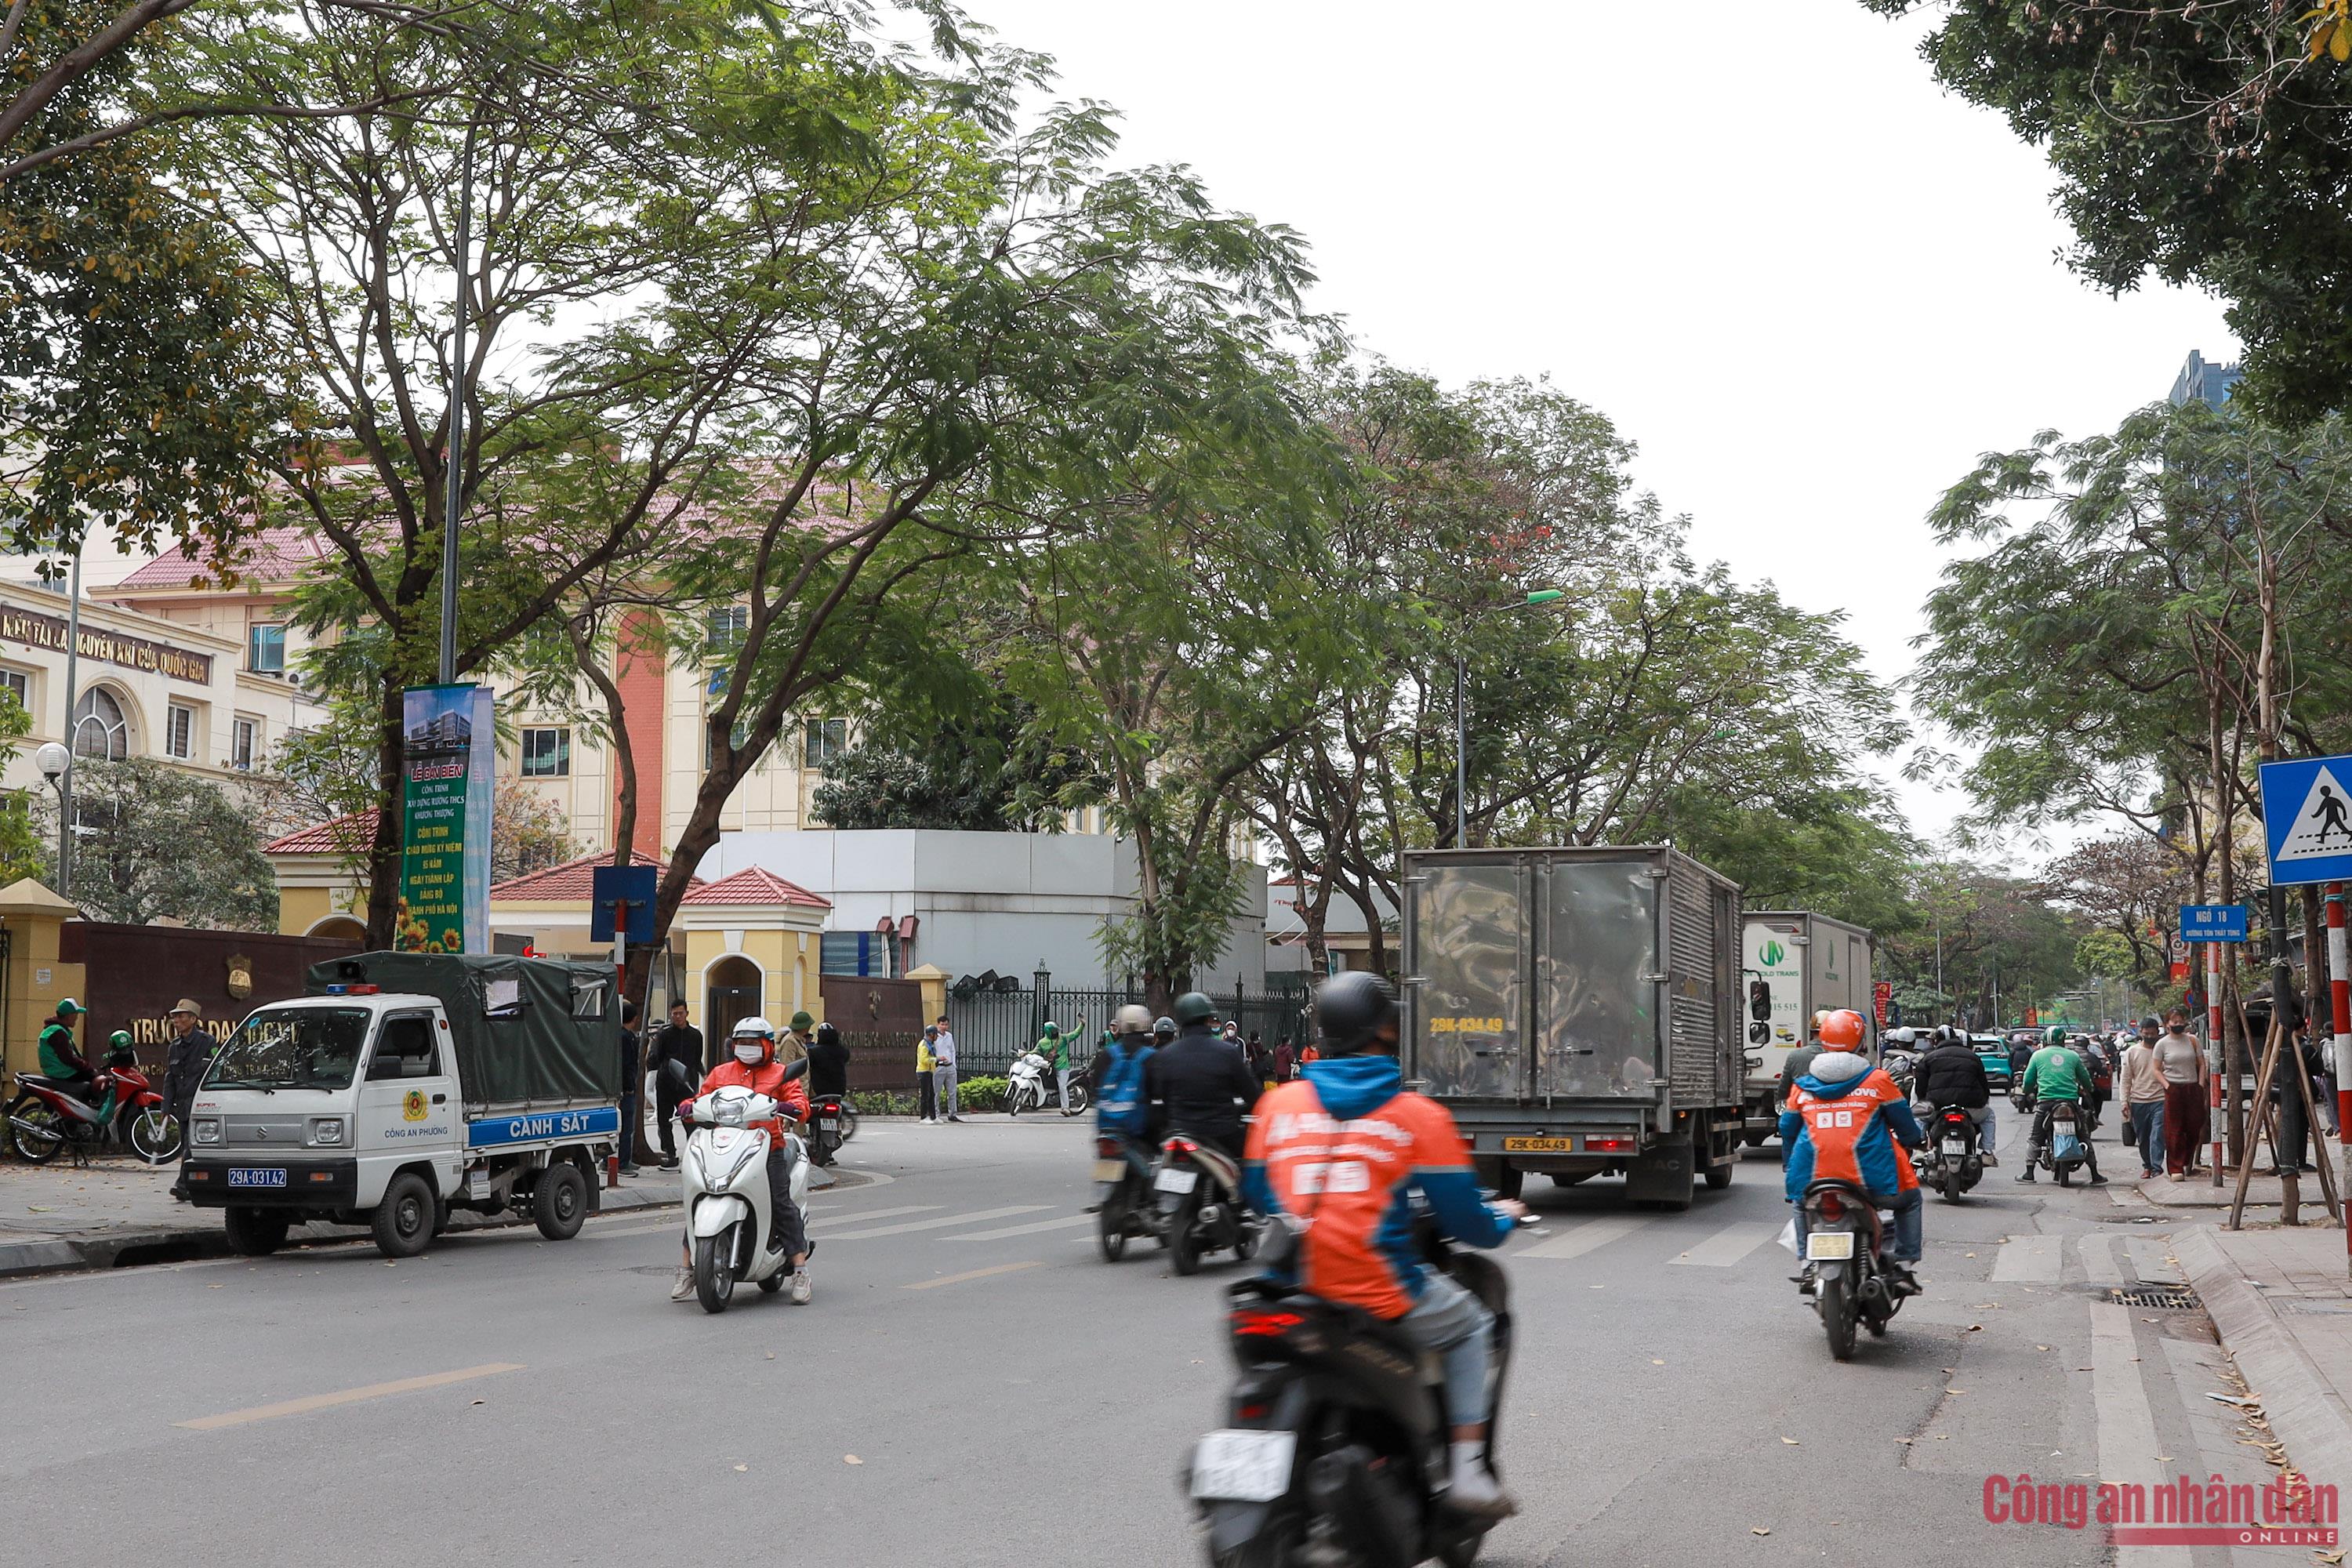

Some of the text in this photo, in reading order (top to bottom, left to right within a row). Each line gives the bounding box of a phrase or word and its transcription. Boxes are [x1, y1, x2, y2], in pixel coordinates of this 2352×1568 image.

[33, 619, 52, 646] TÀI
[116, 641, 136, 665] KHÍ
[136, 642, 158, 669] CỦA
[159, 650, 187, 676] QUỐC
[188, 660, 205, 681] GIA
[412, 757, 464, 782] LỄ GẮN BIỂN
[449, 796, 464, 804] THCS
[2196, 908, 2227, 923] NGÕ 18
[561, 1112, 590, 1133] SÁT
[384, 1125, 448, 1138] CÔNG AN PHƯỜNG
[1511, 1140, 1566, 1149] 29K-034.49
[230, 1171, 285, 1185] 29A-031.42
